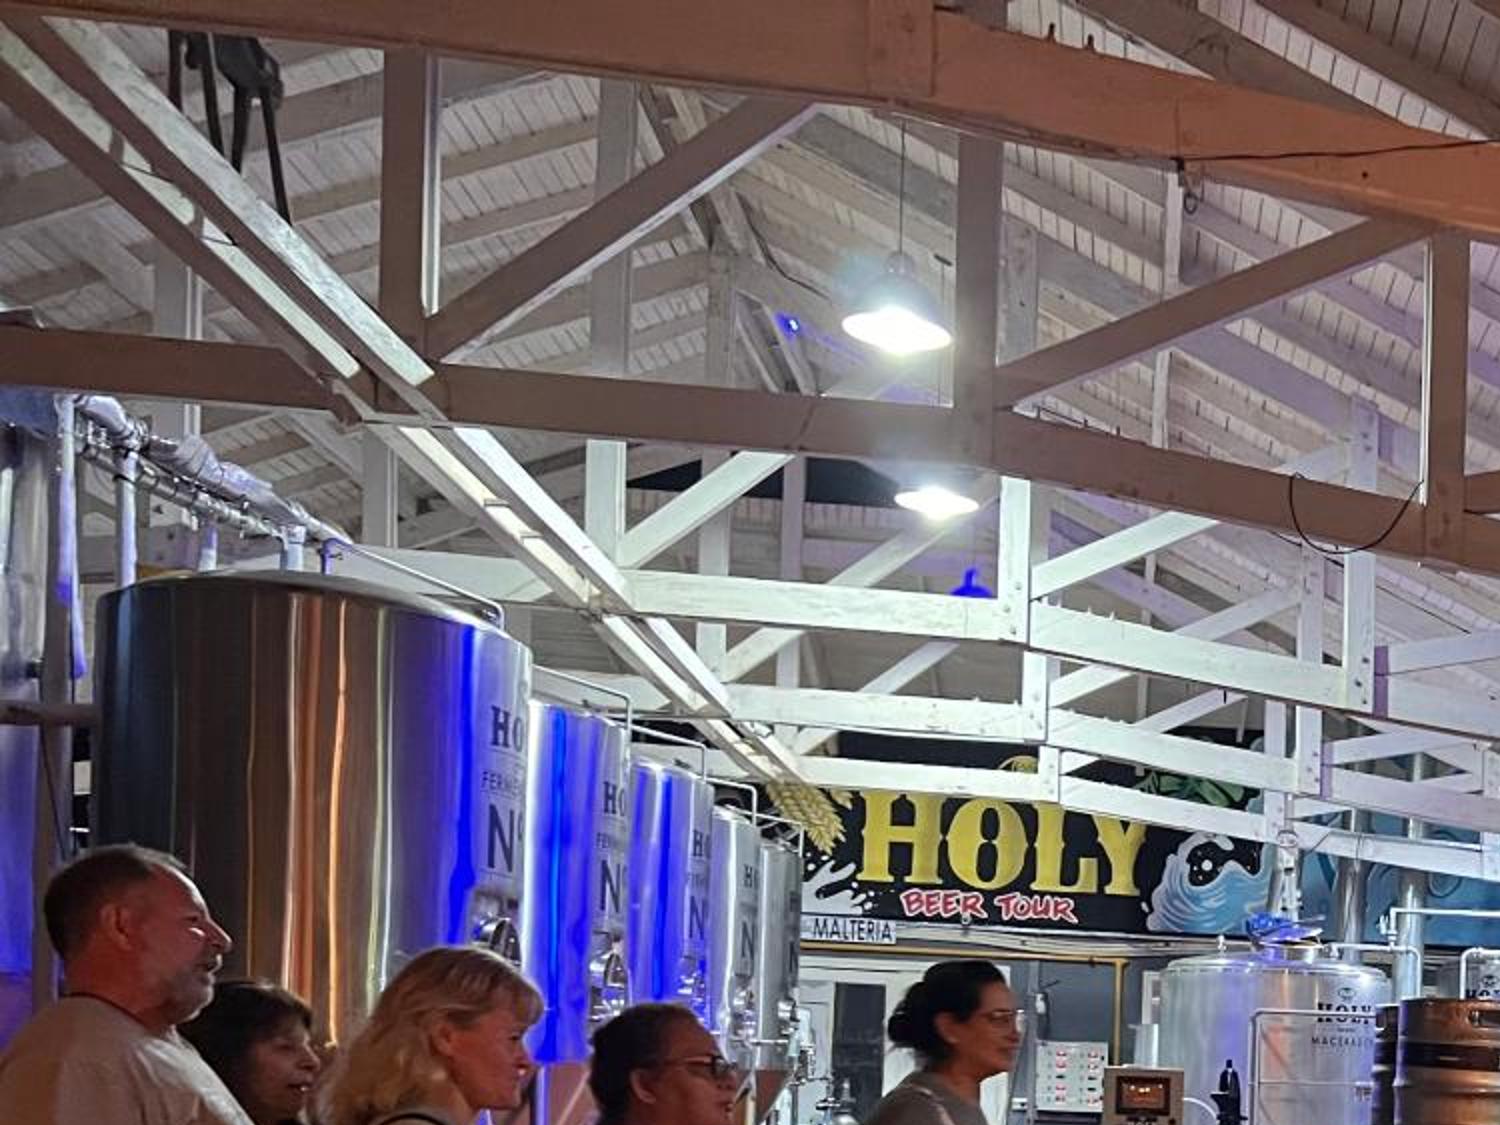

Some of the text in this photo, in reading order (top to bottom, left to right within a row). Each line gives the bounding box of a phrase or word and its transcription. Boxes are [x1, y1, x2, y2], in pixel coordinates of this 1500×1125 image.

[857, 789, 1147, 895] HOLY
[901, 889, 1078, 924] BEER TOUR
